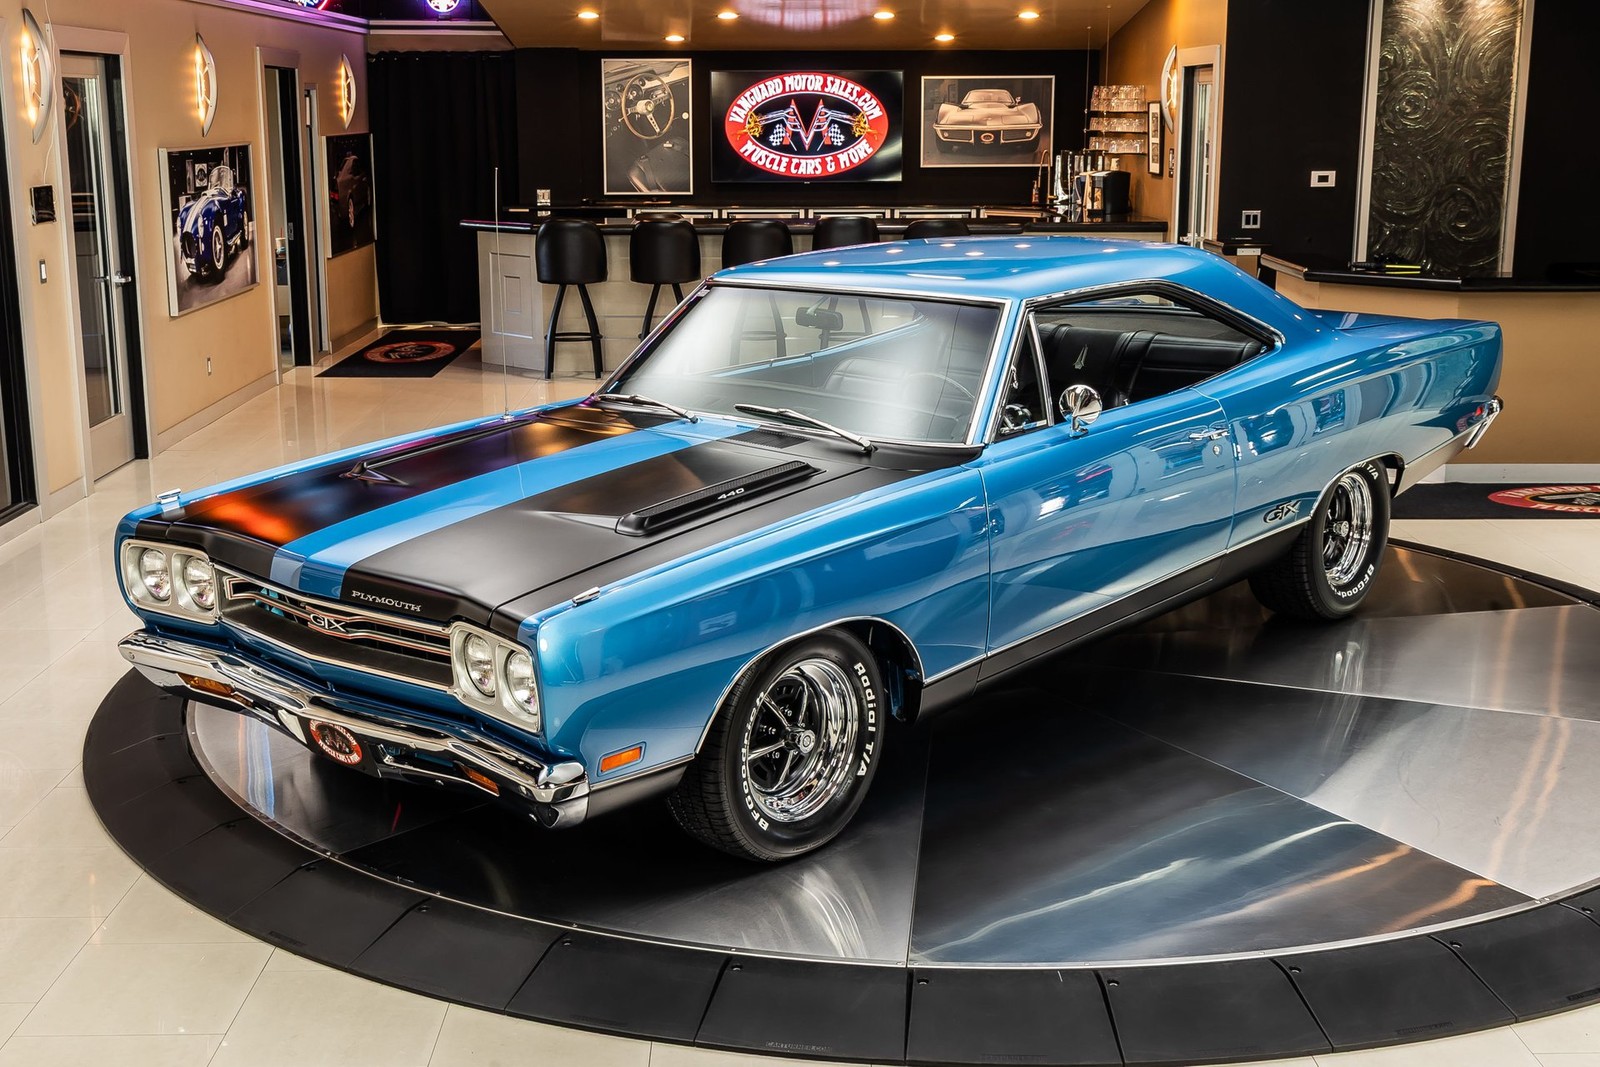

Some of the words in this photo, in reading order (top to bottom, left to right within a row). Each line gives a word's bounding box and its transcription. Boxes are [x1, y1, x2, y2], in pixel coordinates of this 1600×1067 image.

[728, 78, 783, 124] VANGUARD
[783, 74, 824, 93] MOTOR
[824, 76, 884, 121] SALES.COM
[739, 139, 789, 173] MUSCLE
[790, 158, 822, 175] CARS
[825, 155, 836, 173] &
[837, 138, 874, 169] MORE
[1366, 463, 1379, 480] T/A
[717, 487, 745, 500] 440
[1263, 499, 1302, 524] GTX
[1328, 563, 1375, 599] BFGoodri
[351, 590, 422, 612] PLYMOUTH
[310, 613, 348, 632] GTX
[853, 662, 877, 732] Radial
[856, 741, 875, 776] T/A
